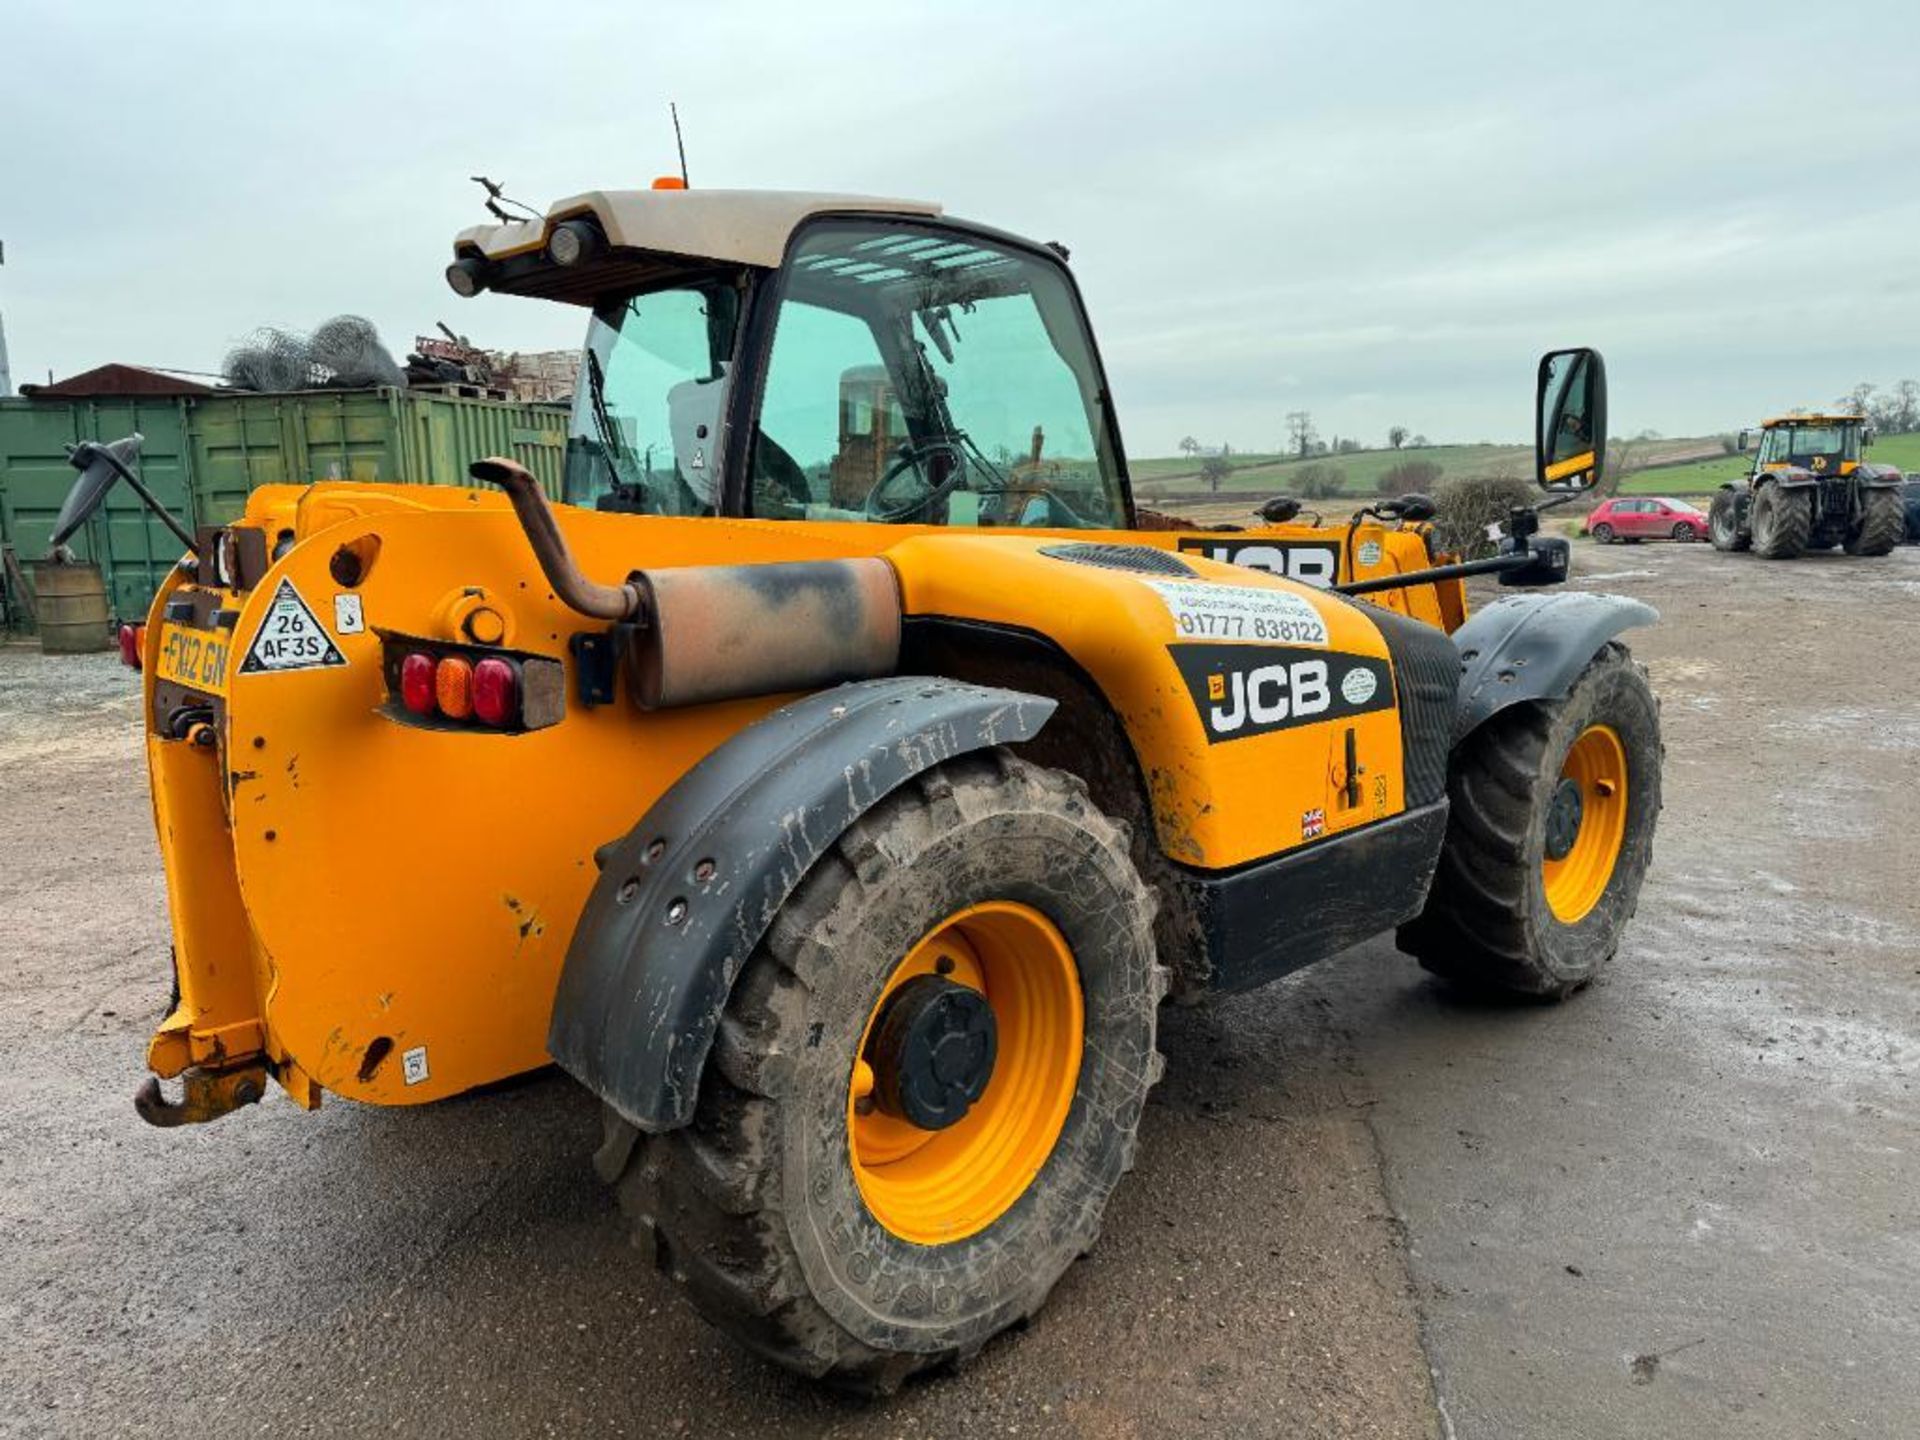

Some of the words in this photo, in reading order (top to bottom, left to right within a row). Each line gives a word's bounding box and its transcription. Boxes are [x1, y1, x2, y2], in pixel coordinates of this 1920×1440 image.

[277, 613, 304, 634] 26
[1179, 612, 1245, 637] 01777
[1253, 617, 1324, 643] 838122
[263, 636, 320, 659] AF3S
[1210, 659, 1331, 734] JCB
